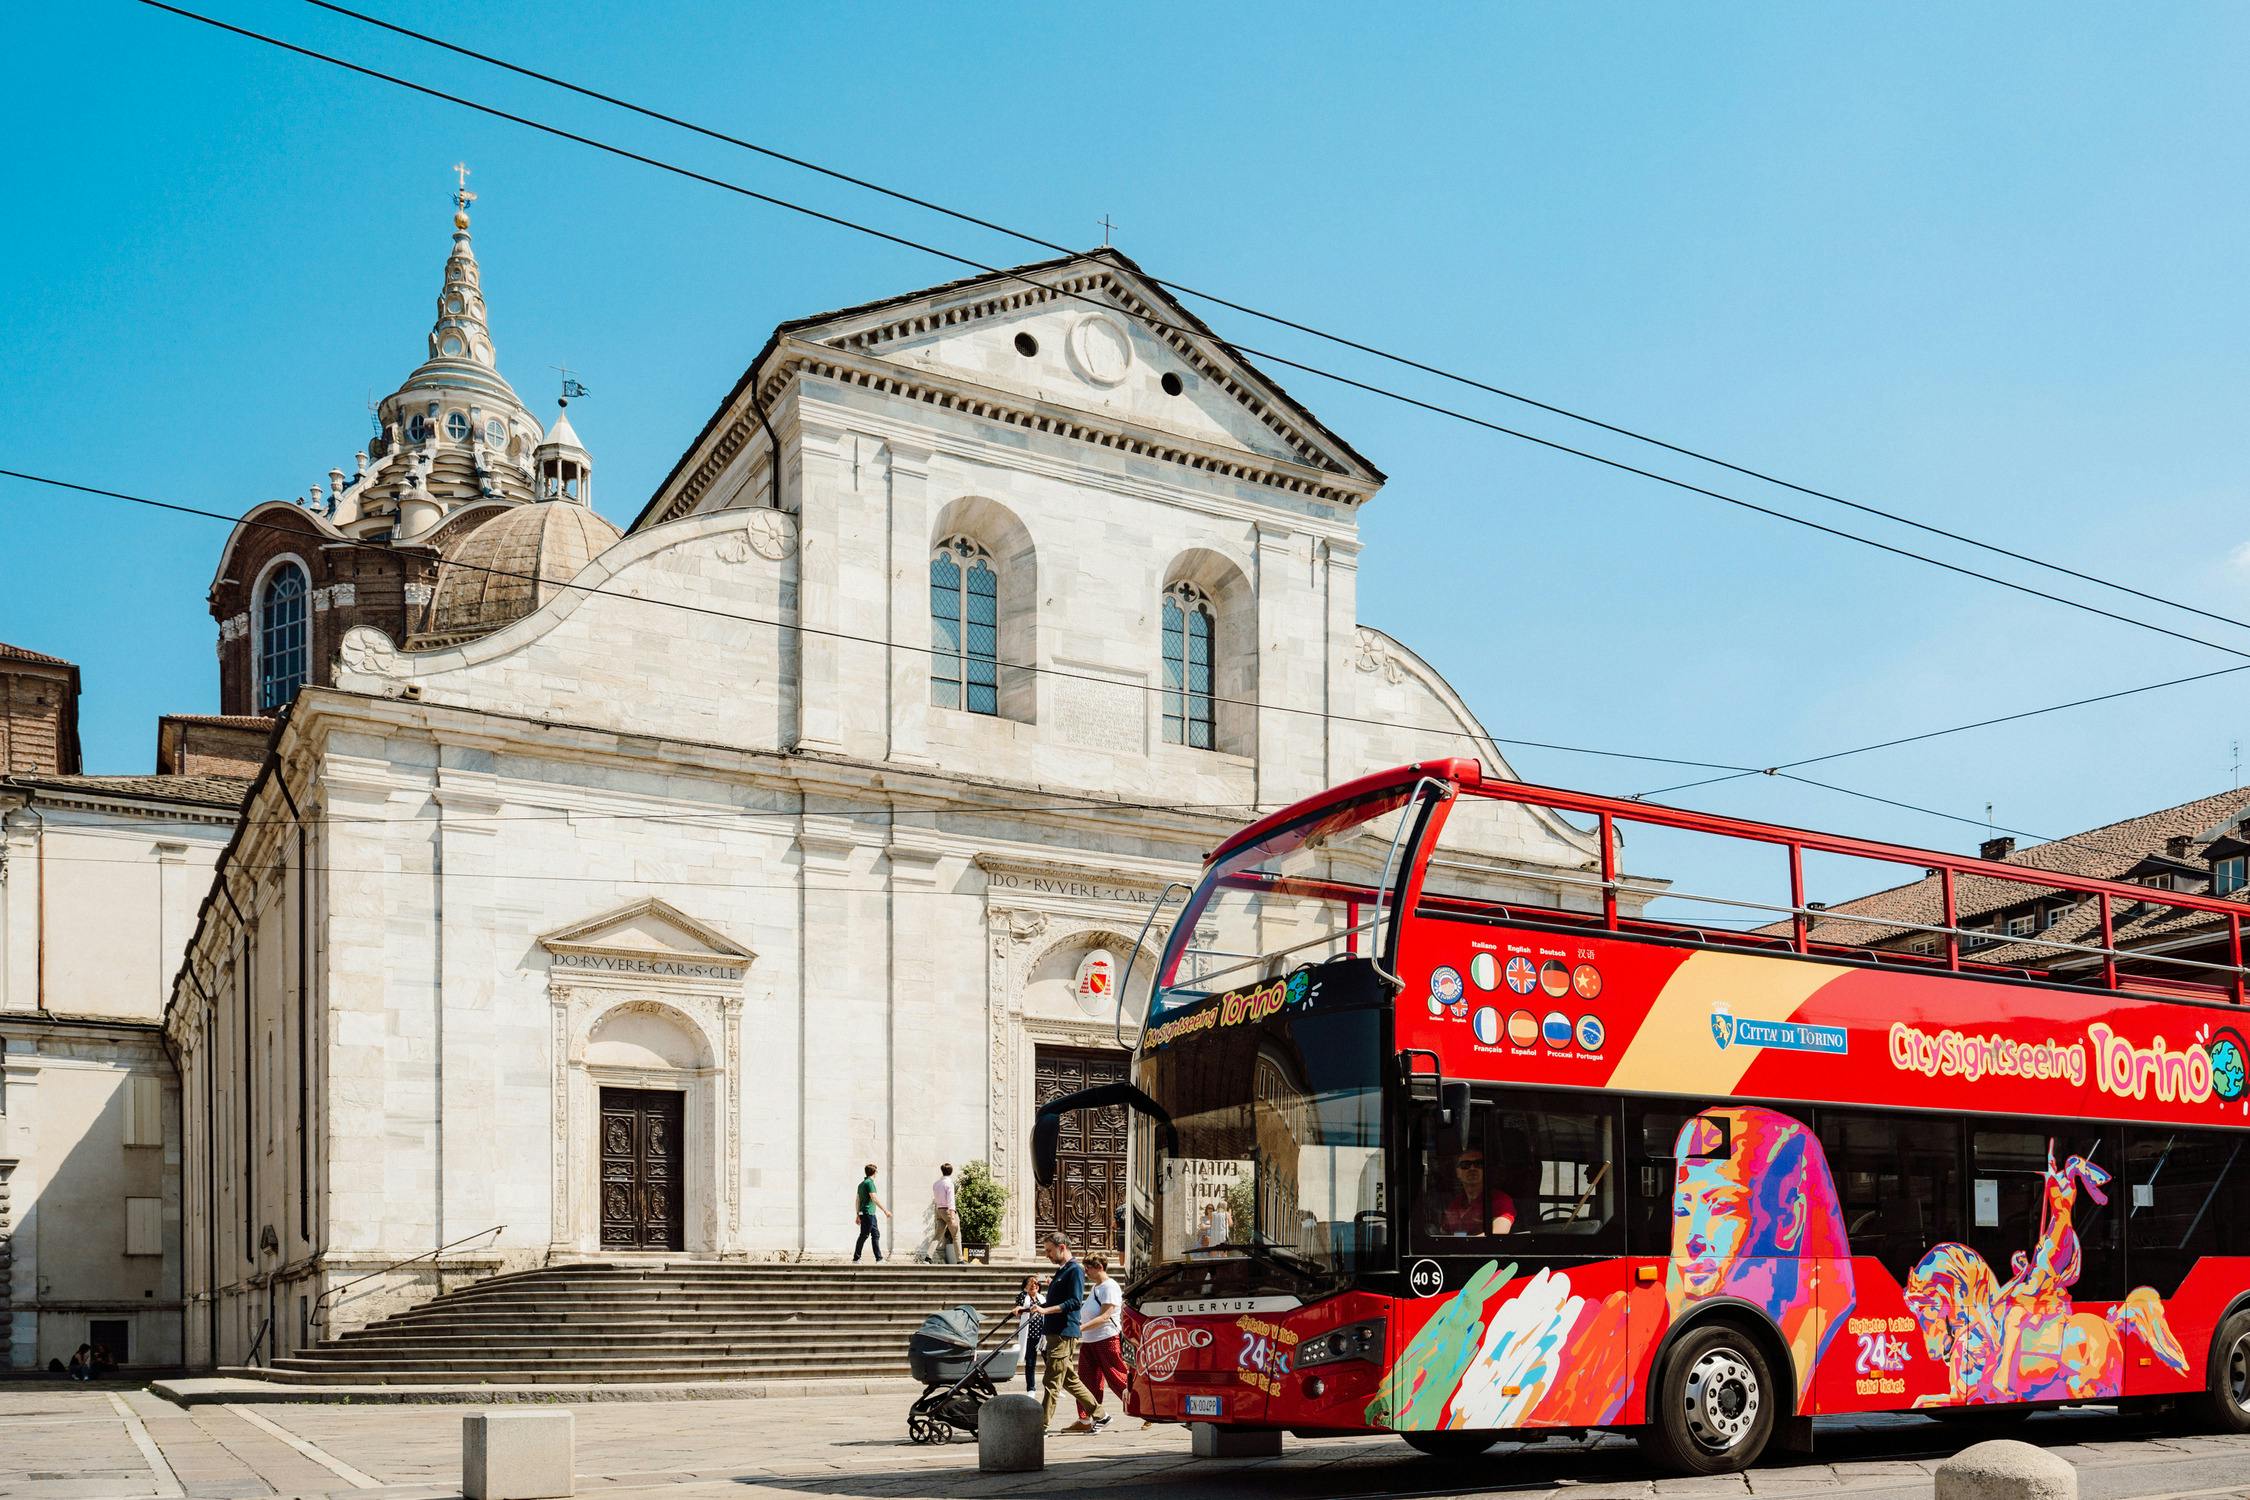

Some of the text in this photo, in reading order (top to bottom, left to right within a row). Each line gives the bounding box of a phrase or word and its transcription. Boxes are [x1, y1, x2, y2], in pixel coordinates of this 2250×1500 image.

[1472, 941, 1497, 950] Italiano
[1508, 945, 1531, 953] English
[1540, 947, 1566, 957] Deutsch
[1577, 948, 1595, 959] 汉语
[1221, 980, 1287, 1027] Torino
[1474, 1045, 1502, 1053] Français
[1511, 1048, 1536, 1056] Español
[2089, 1023, 2214, 1103] Torino
[1413, 1272, 1440, 1285] 40 S
[1849, 1317, 1915, 1336] Biglietto Valido
[1140, 1332, 1187, 1368] OFFICIAL
[1240, 1333, 1265, 1369] 24
[1857, 1334, 1886, 1374] 24
[1154, 1356, 1177, 1376] TOUR
[1857, 1378, 1905, 1395] Valid Ticket
